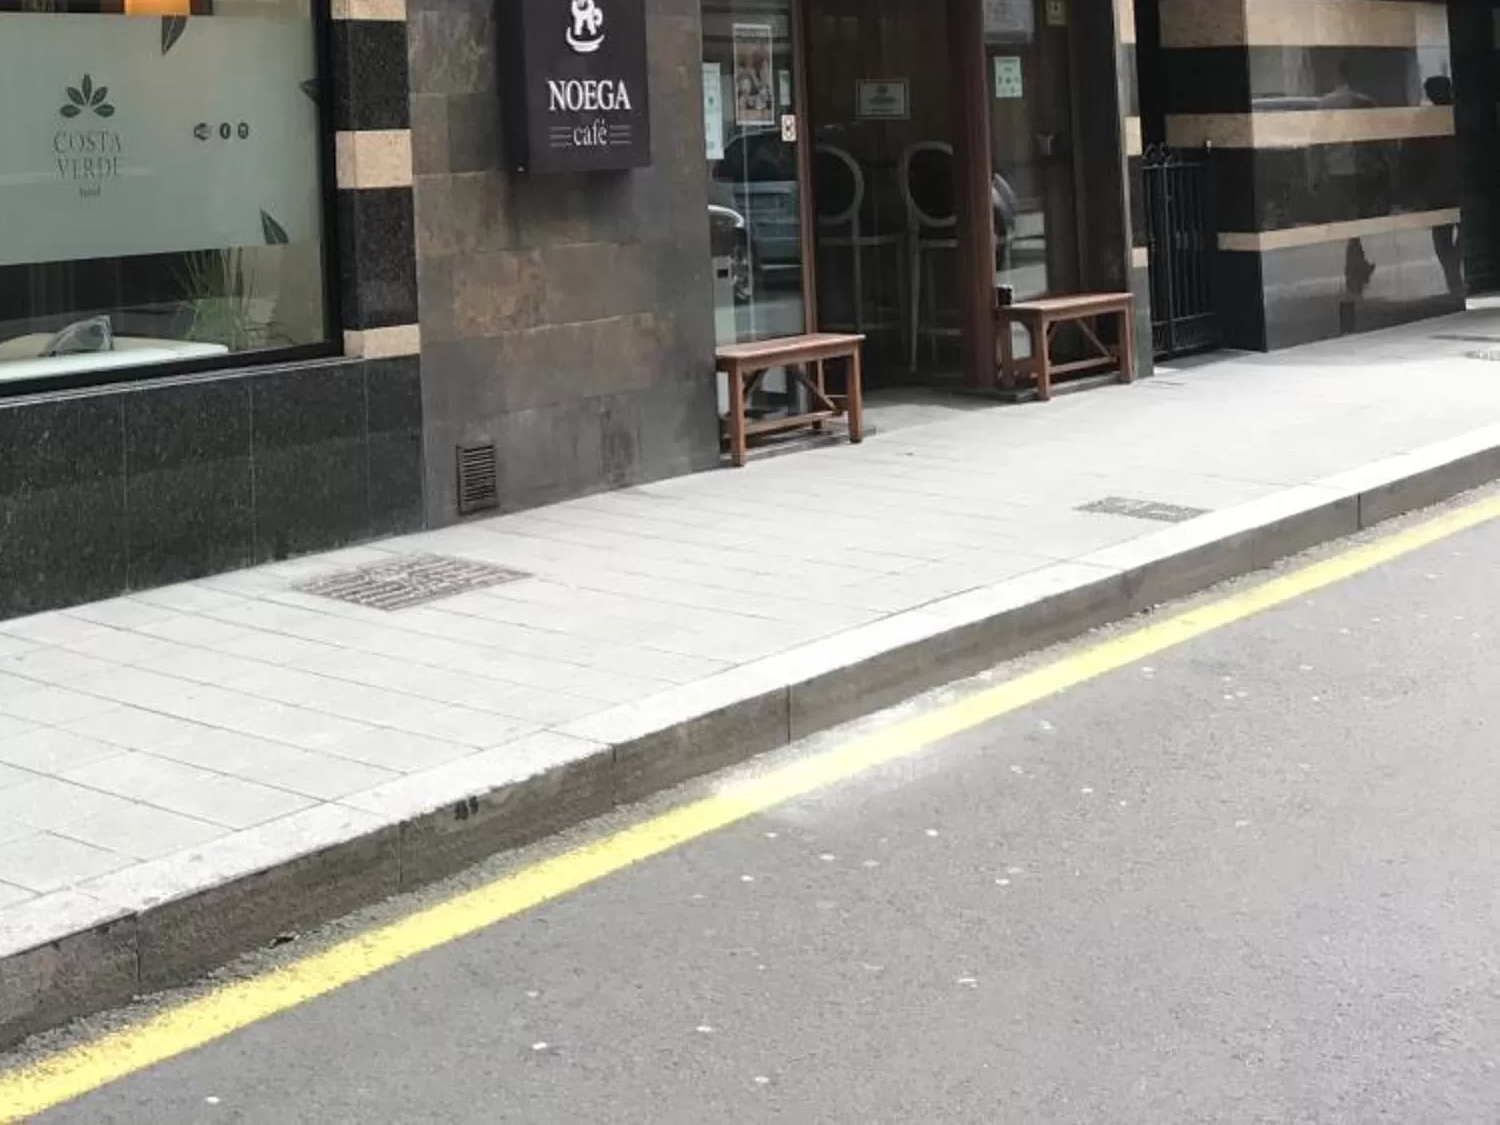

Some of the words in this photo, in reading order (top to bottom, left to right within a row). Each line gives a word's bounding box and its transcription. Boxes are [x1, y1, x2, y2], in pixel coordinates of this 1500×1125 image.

[548, 79, 632, 111] NOEGA
[52, 129, 122, 154] COSTA
[572, 119, 608, 146] café
[56, 157, 123, 179] VERDE
